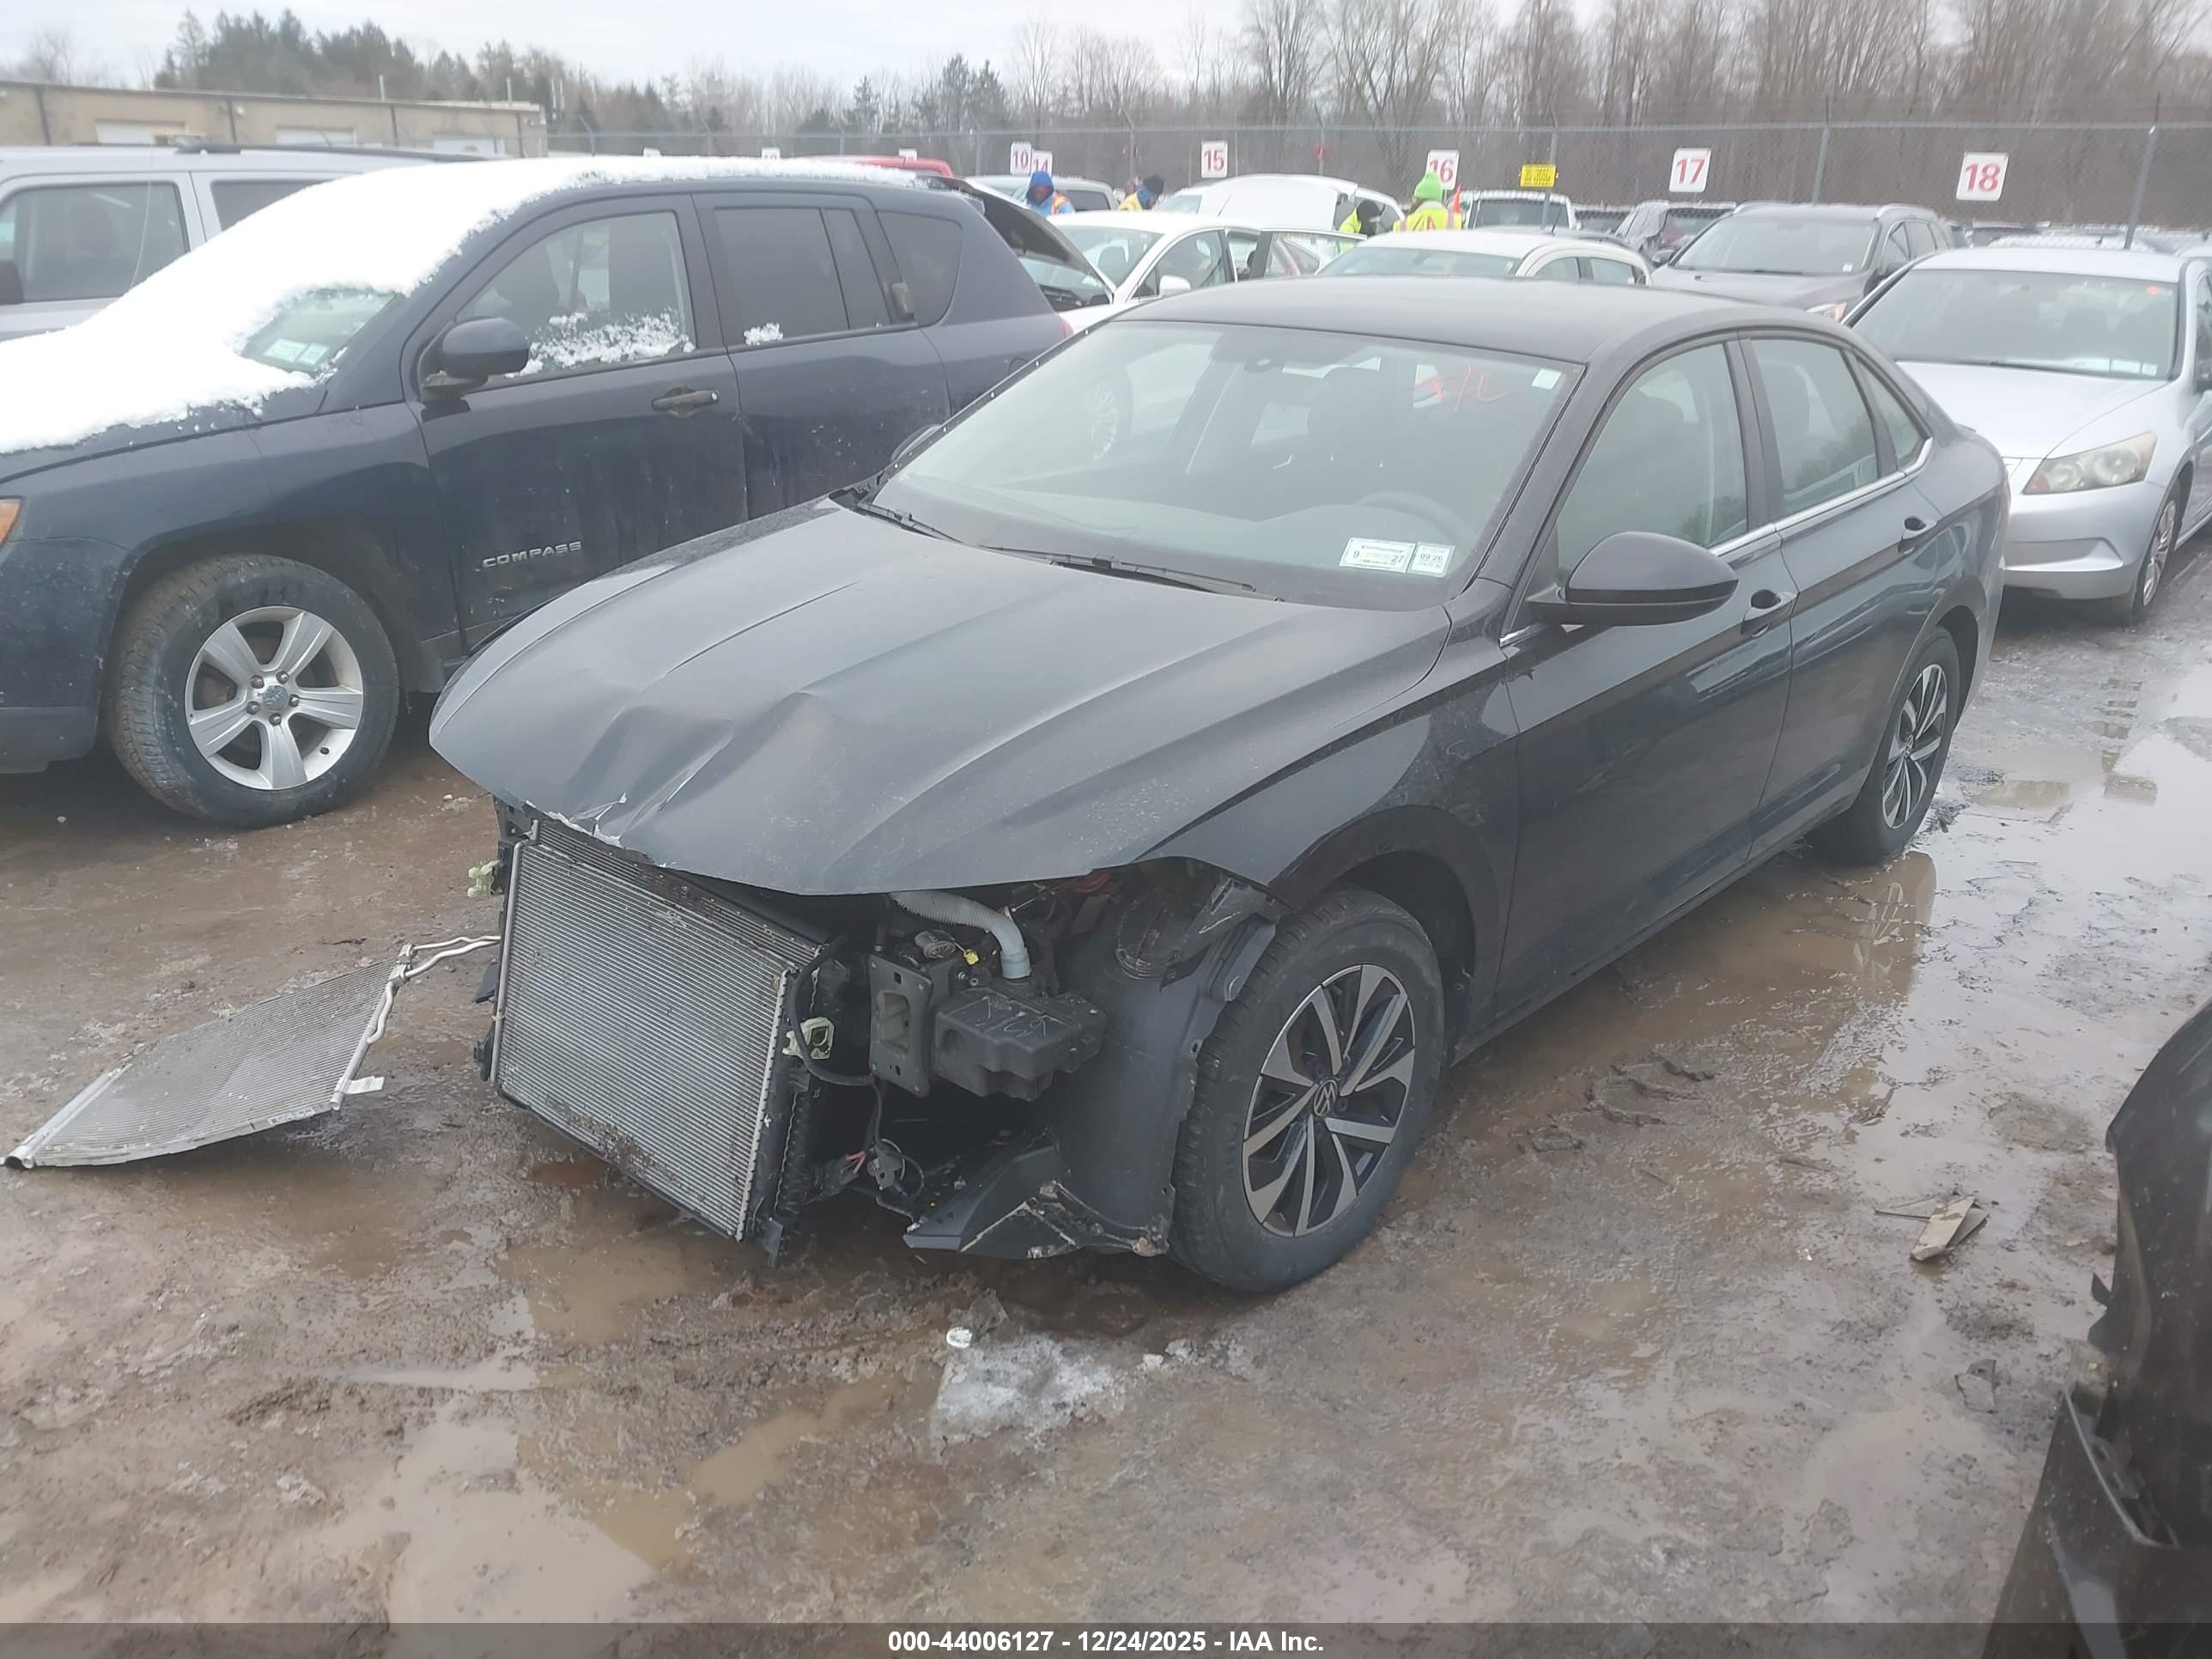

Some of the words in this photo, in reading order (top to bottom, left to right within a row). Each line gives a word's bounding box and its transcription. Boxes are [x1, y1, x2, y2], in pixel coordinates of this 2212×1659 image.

[1013, 150, 1029, 168] 10
[1204, 150, 1224, 172] 15
[1429, 159, 1454, 183] 16
[1676, 158, 1705, 185] 17
[1965, 163, 2001, 191] 18
[483, 541, 582, 568] COMPASS
[1390, 555, 1405, 564] 27
